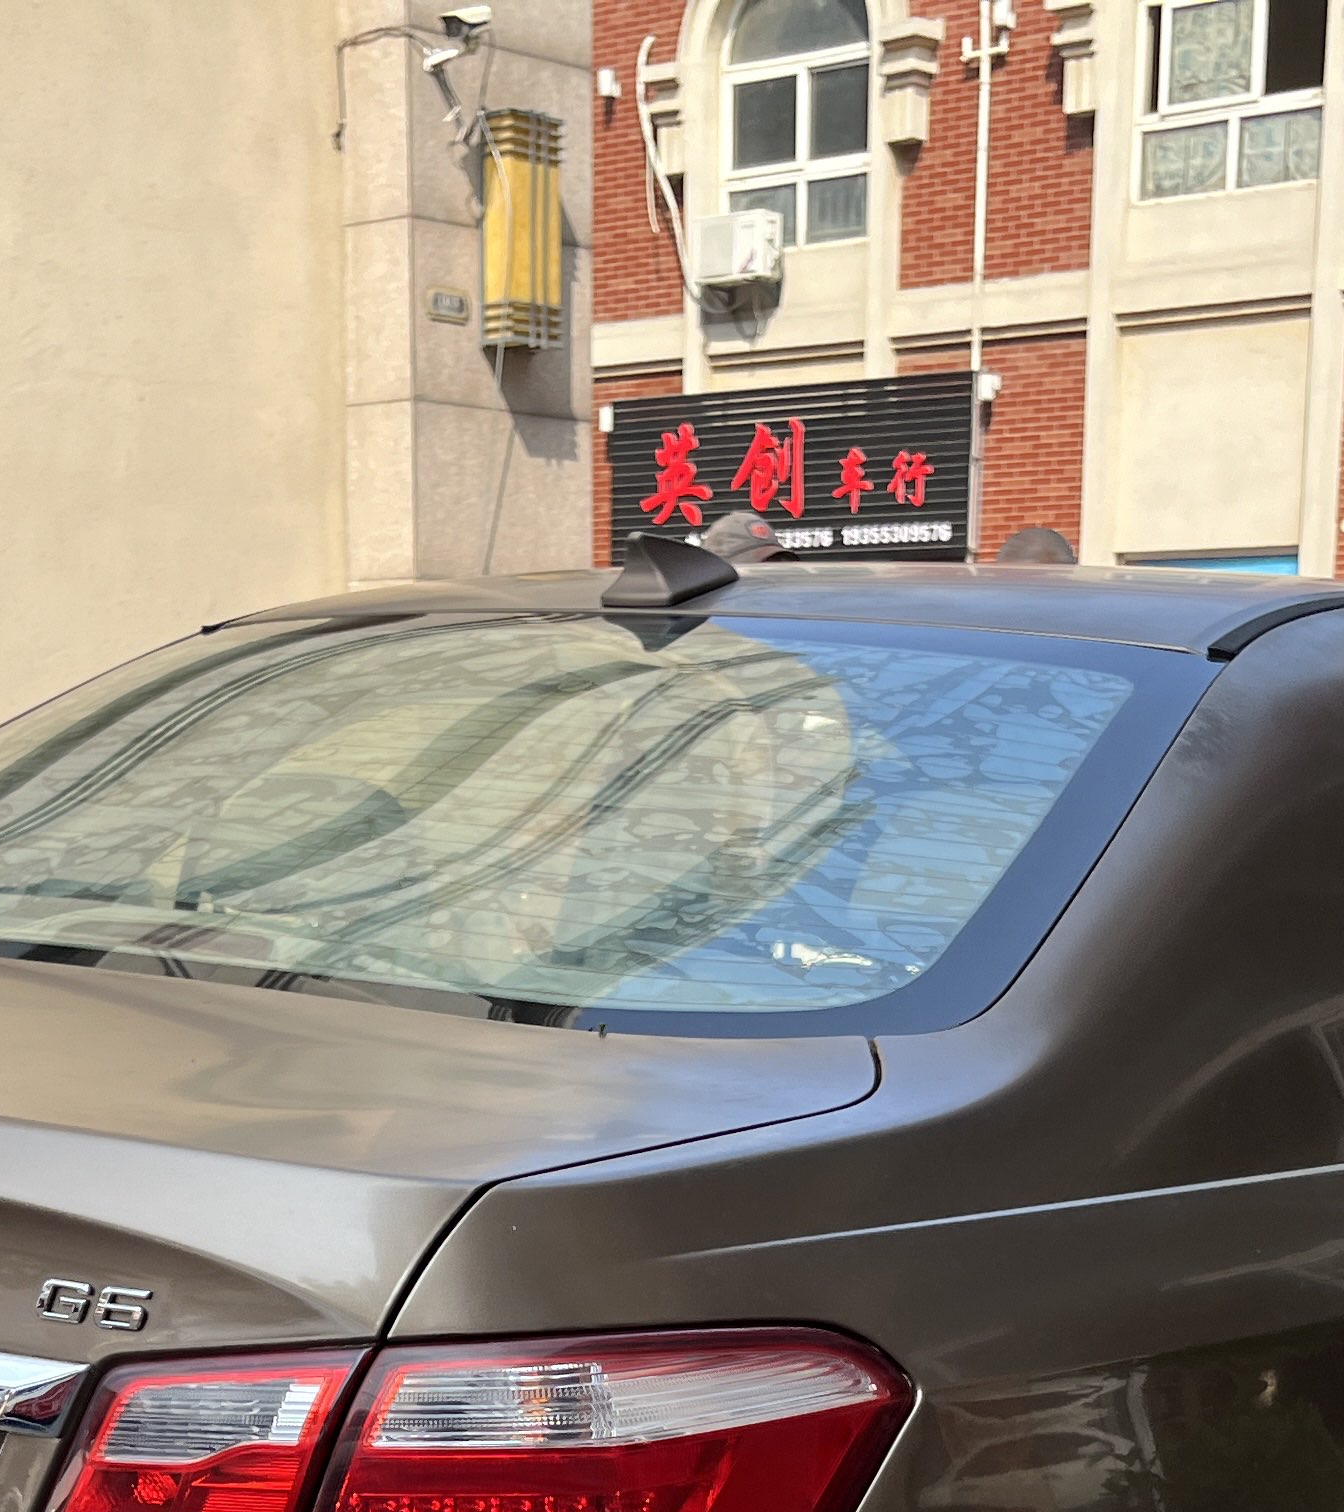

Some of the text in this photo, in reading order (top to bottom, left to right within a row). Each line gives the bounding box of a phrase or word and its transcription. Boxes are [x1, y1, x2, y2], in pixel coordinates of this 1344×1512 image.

[640, 417, 935, 526] 英创车行
[36, 1278, 153, 1331] G6
